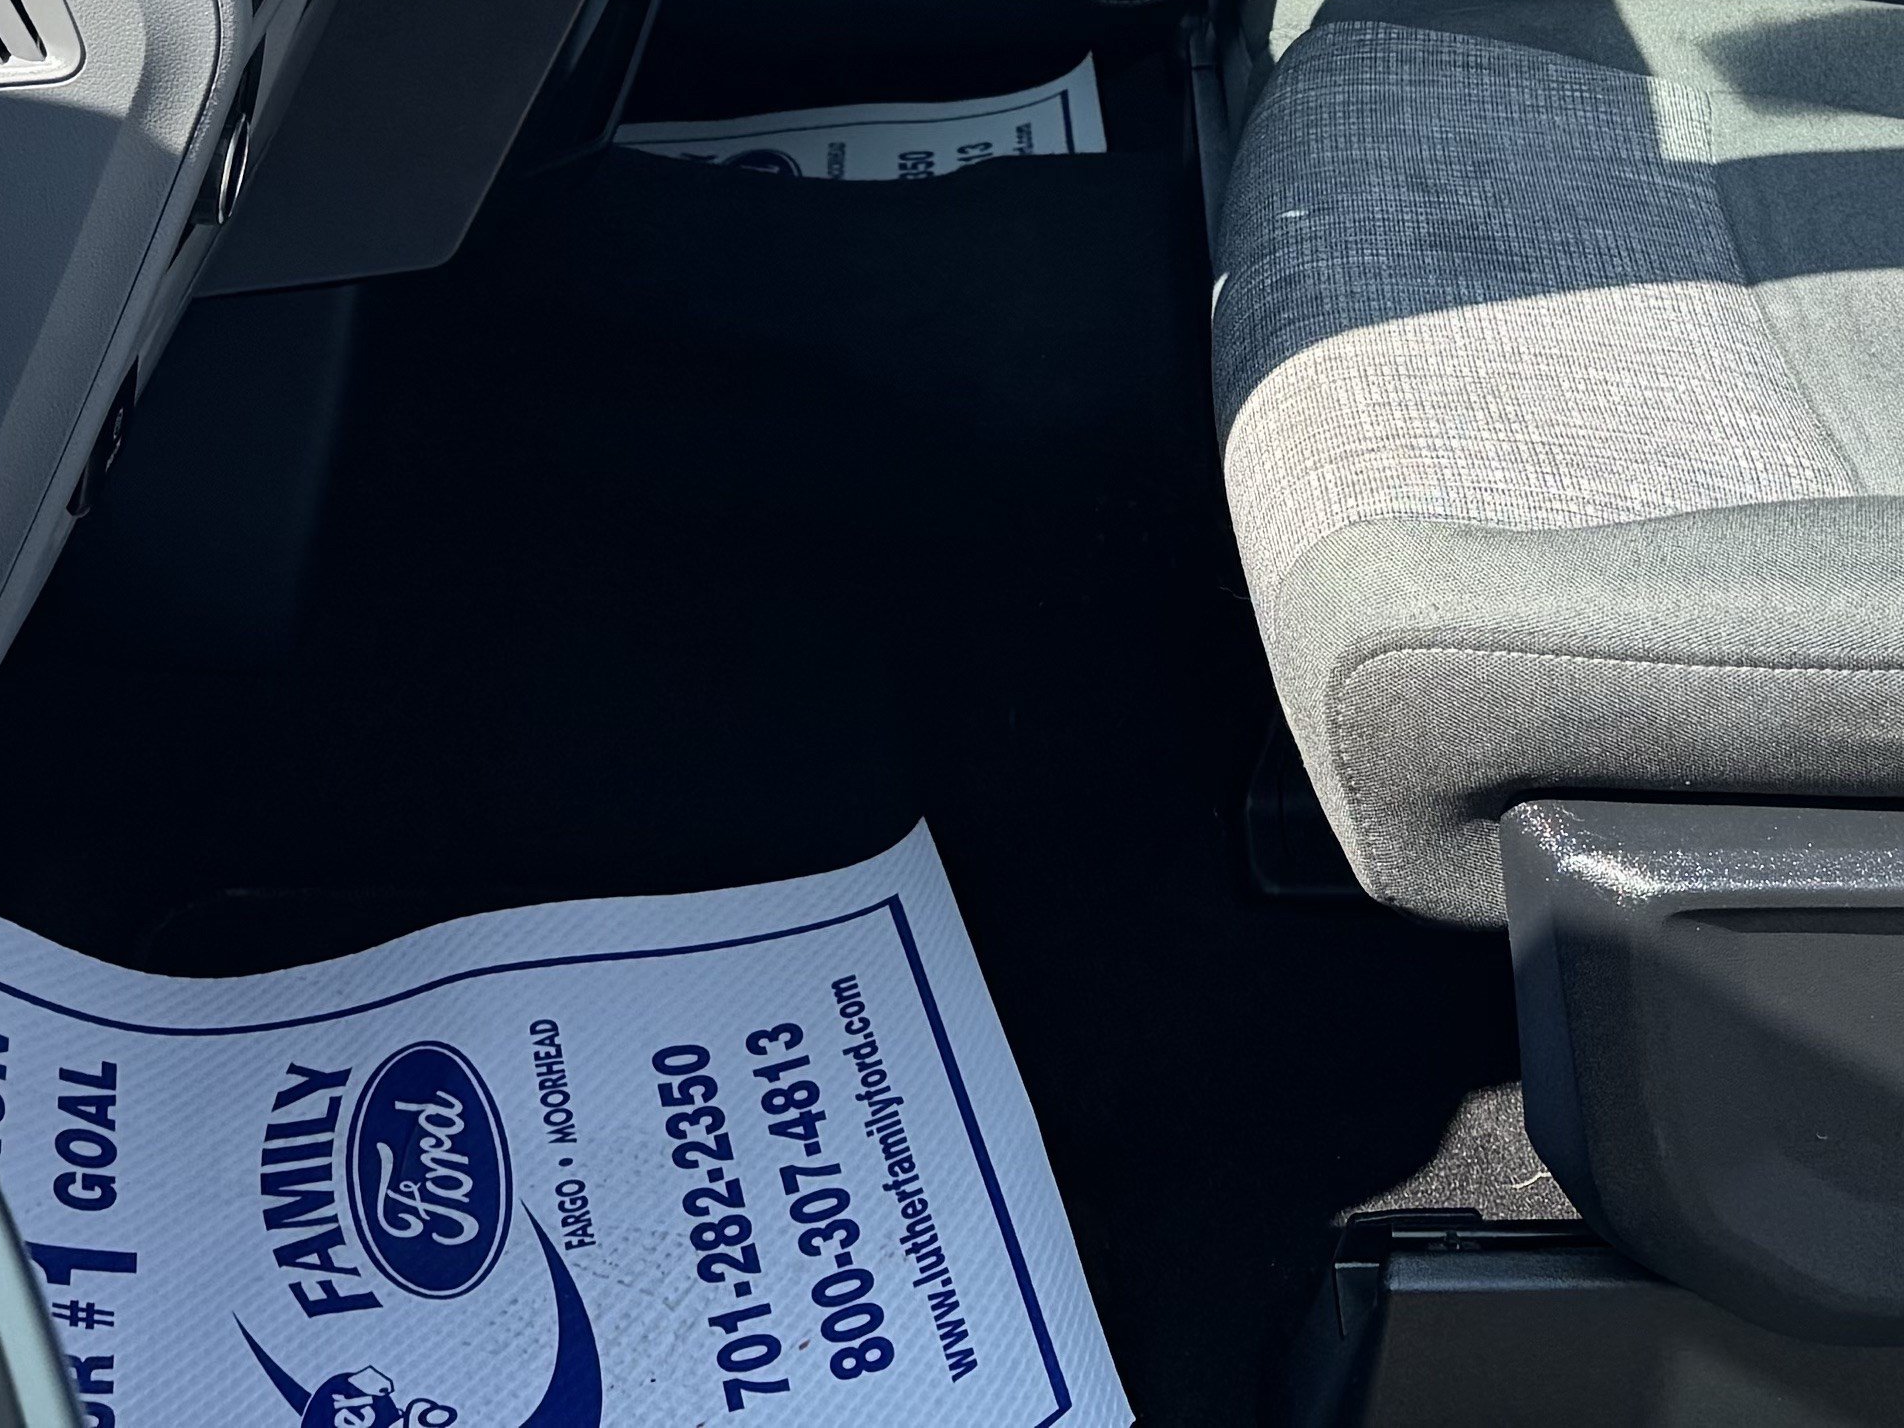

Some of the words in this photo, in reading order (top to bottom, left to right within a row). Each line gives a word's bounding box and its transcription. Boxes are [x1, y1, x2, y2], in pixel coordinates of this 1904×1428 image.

[53, 1060, 118, 1212] GOAL
[376, 1089, 480, 1245] Ford
[529, 1018, 578, 1144] MOORHEAD
[830, 974, 979, 1384] www.lutherfamilyford.com
[259, 1061, 384, 1319] FAMILY
[554, 1178, 597, 1251] FARGO
[651, 1043, 791, 1413] 701-282-2350
[745, 1021, 895, 1381] 800-307-4813
